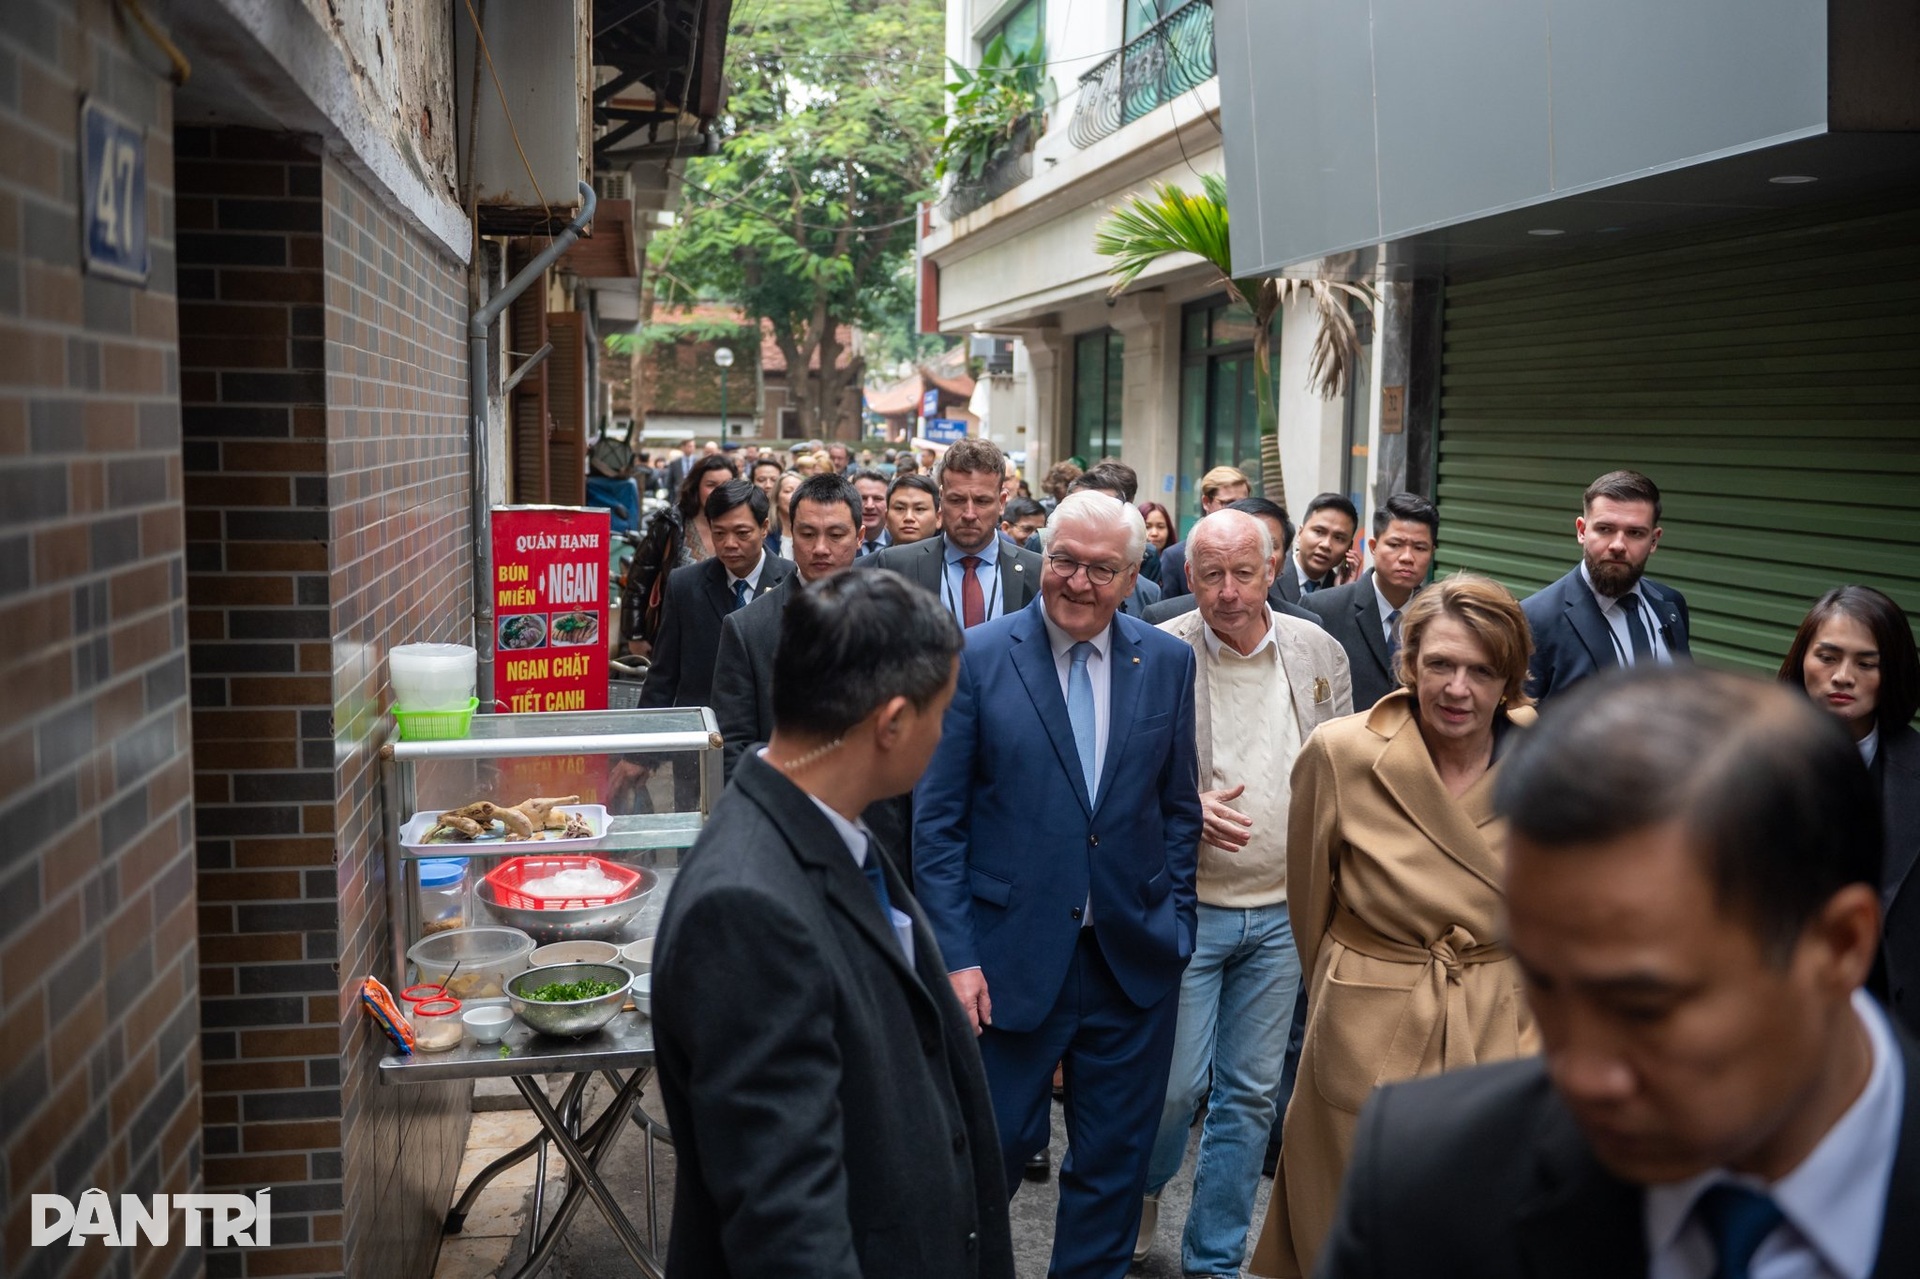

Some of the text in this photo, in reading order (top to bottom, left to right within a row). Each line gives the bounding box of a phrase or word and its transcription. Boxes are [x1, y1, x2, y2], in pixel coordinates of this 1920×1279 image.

[97, 136, 136, 253] 47
[516, 531, 599, 553] QUÁN HẠNH
[498, 562, 529, 582] BÚN
[548, 562, 599, 605] NGAN
[498, 584, 536, 607] MIẾN
[506, 652, 590, 682] NGAN CHẶT
[511, 687, 585, 713] TIẾT CANH
